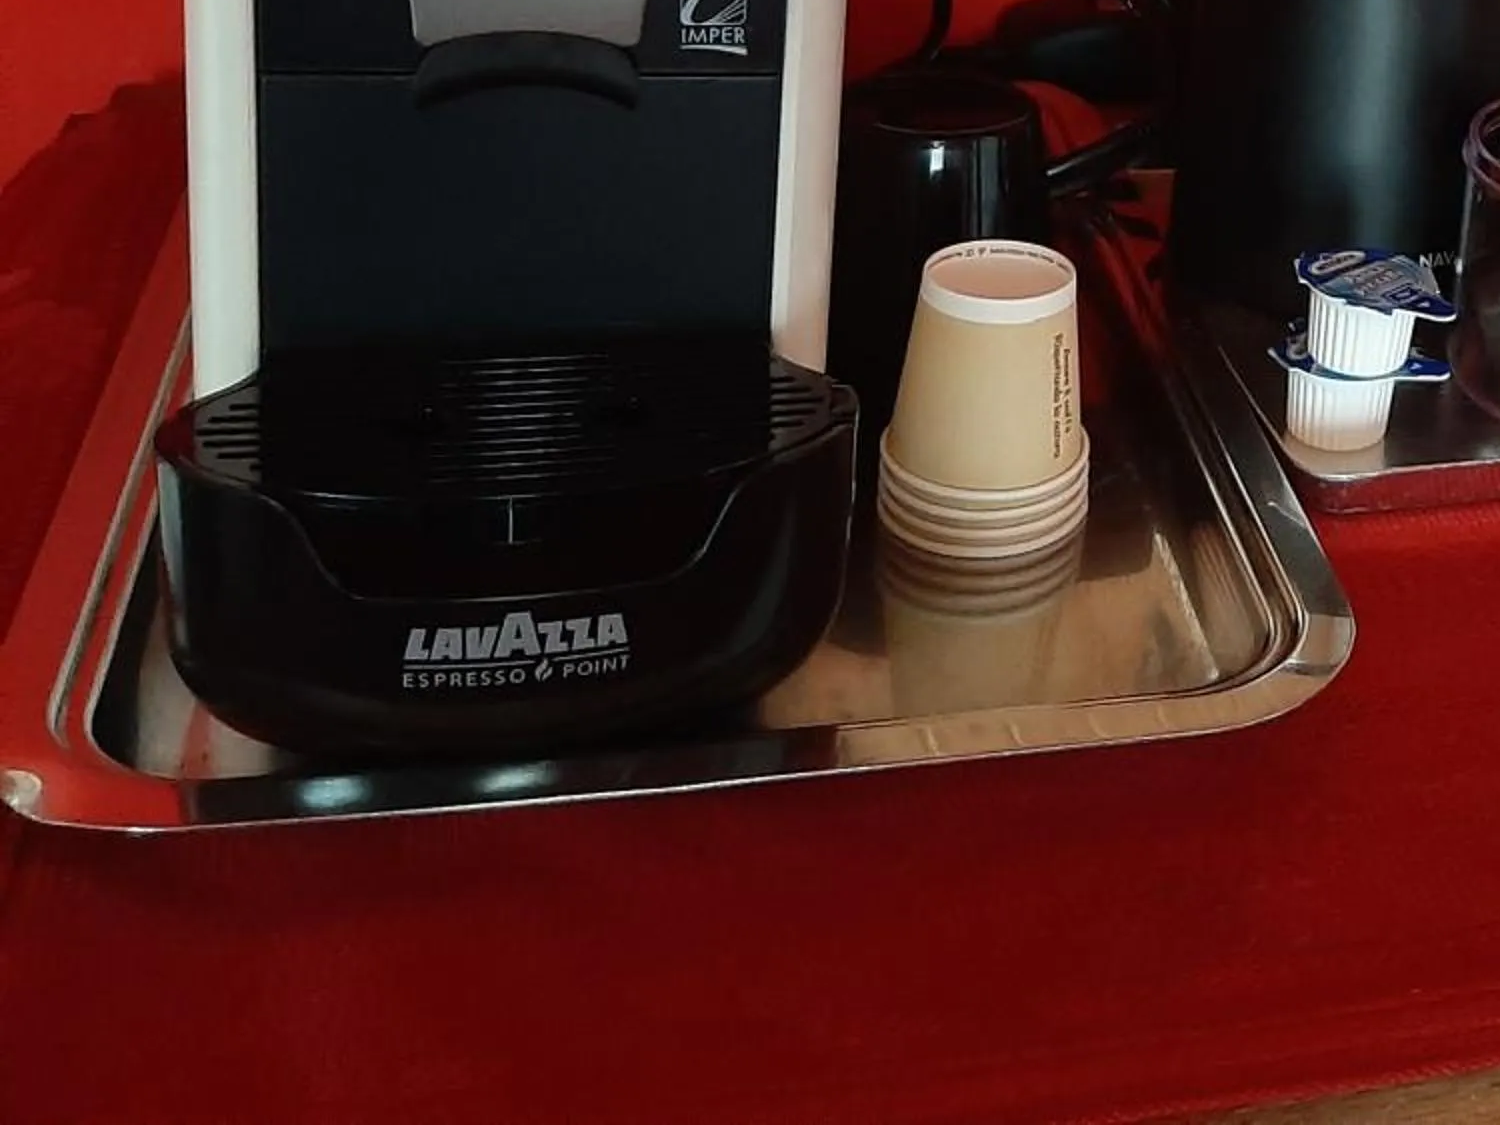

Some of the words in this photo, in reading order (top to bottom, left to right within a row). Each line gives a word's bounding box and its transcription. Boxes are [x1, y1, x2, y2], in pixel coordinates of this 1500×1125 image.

[680, 26, 746, 45] IMPER
[1418, 250, 1455, 269] NAV
[403, 611, 628, 660] LAVAZZA
[402, 668, 526, 688] ESPRESSO
[562, 655, 630, 678] POINT
